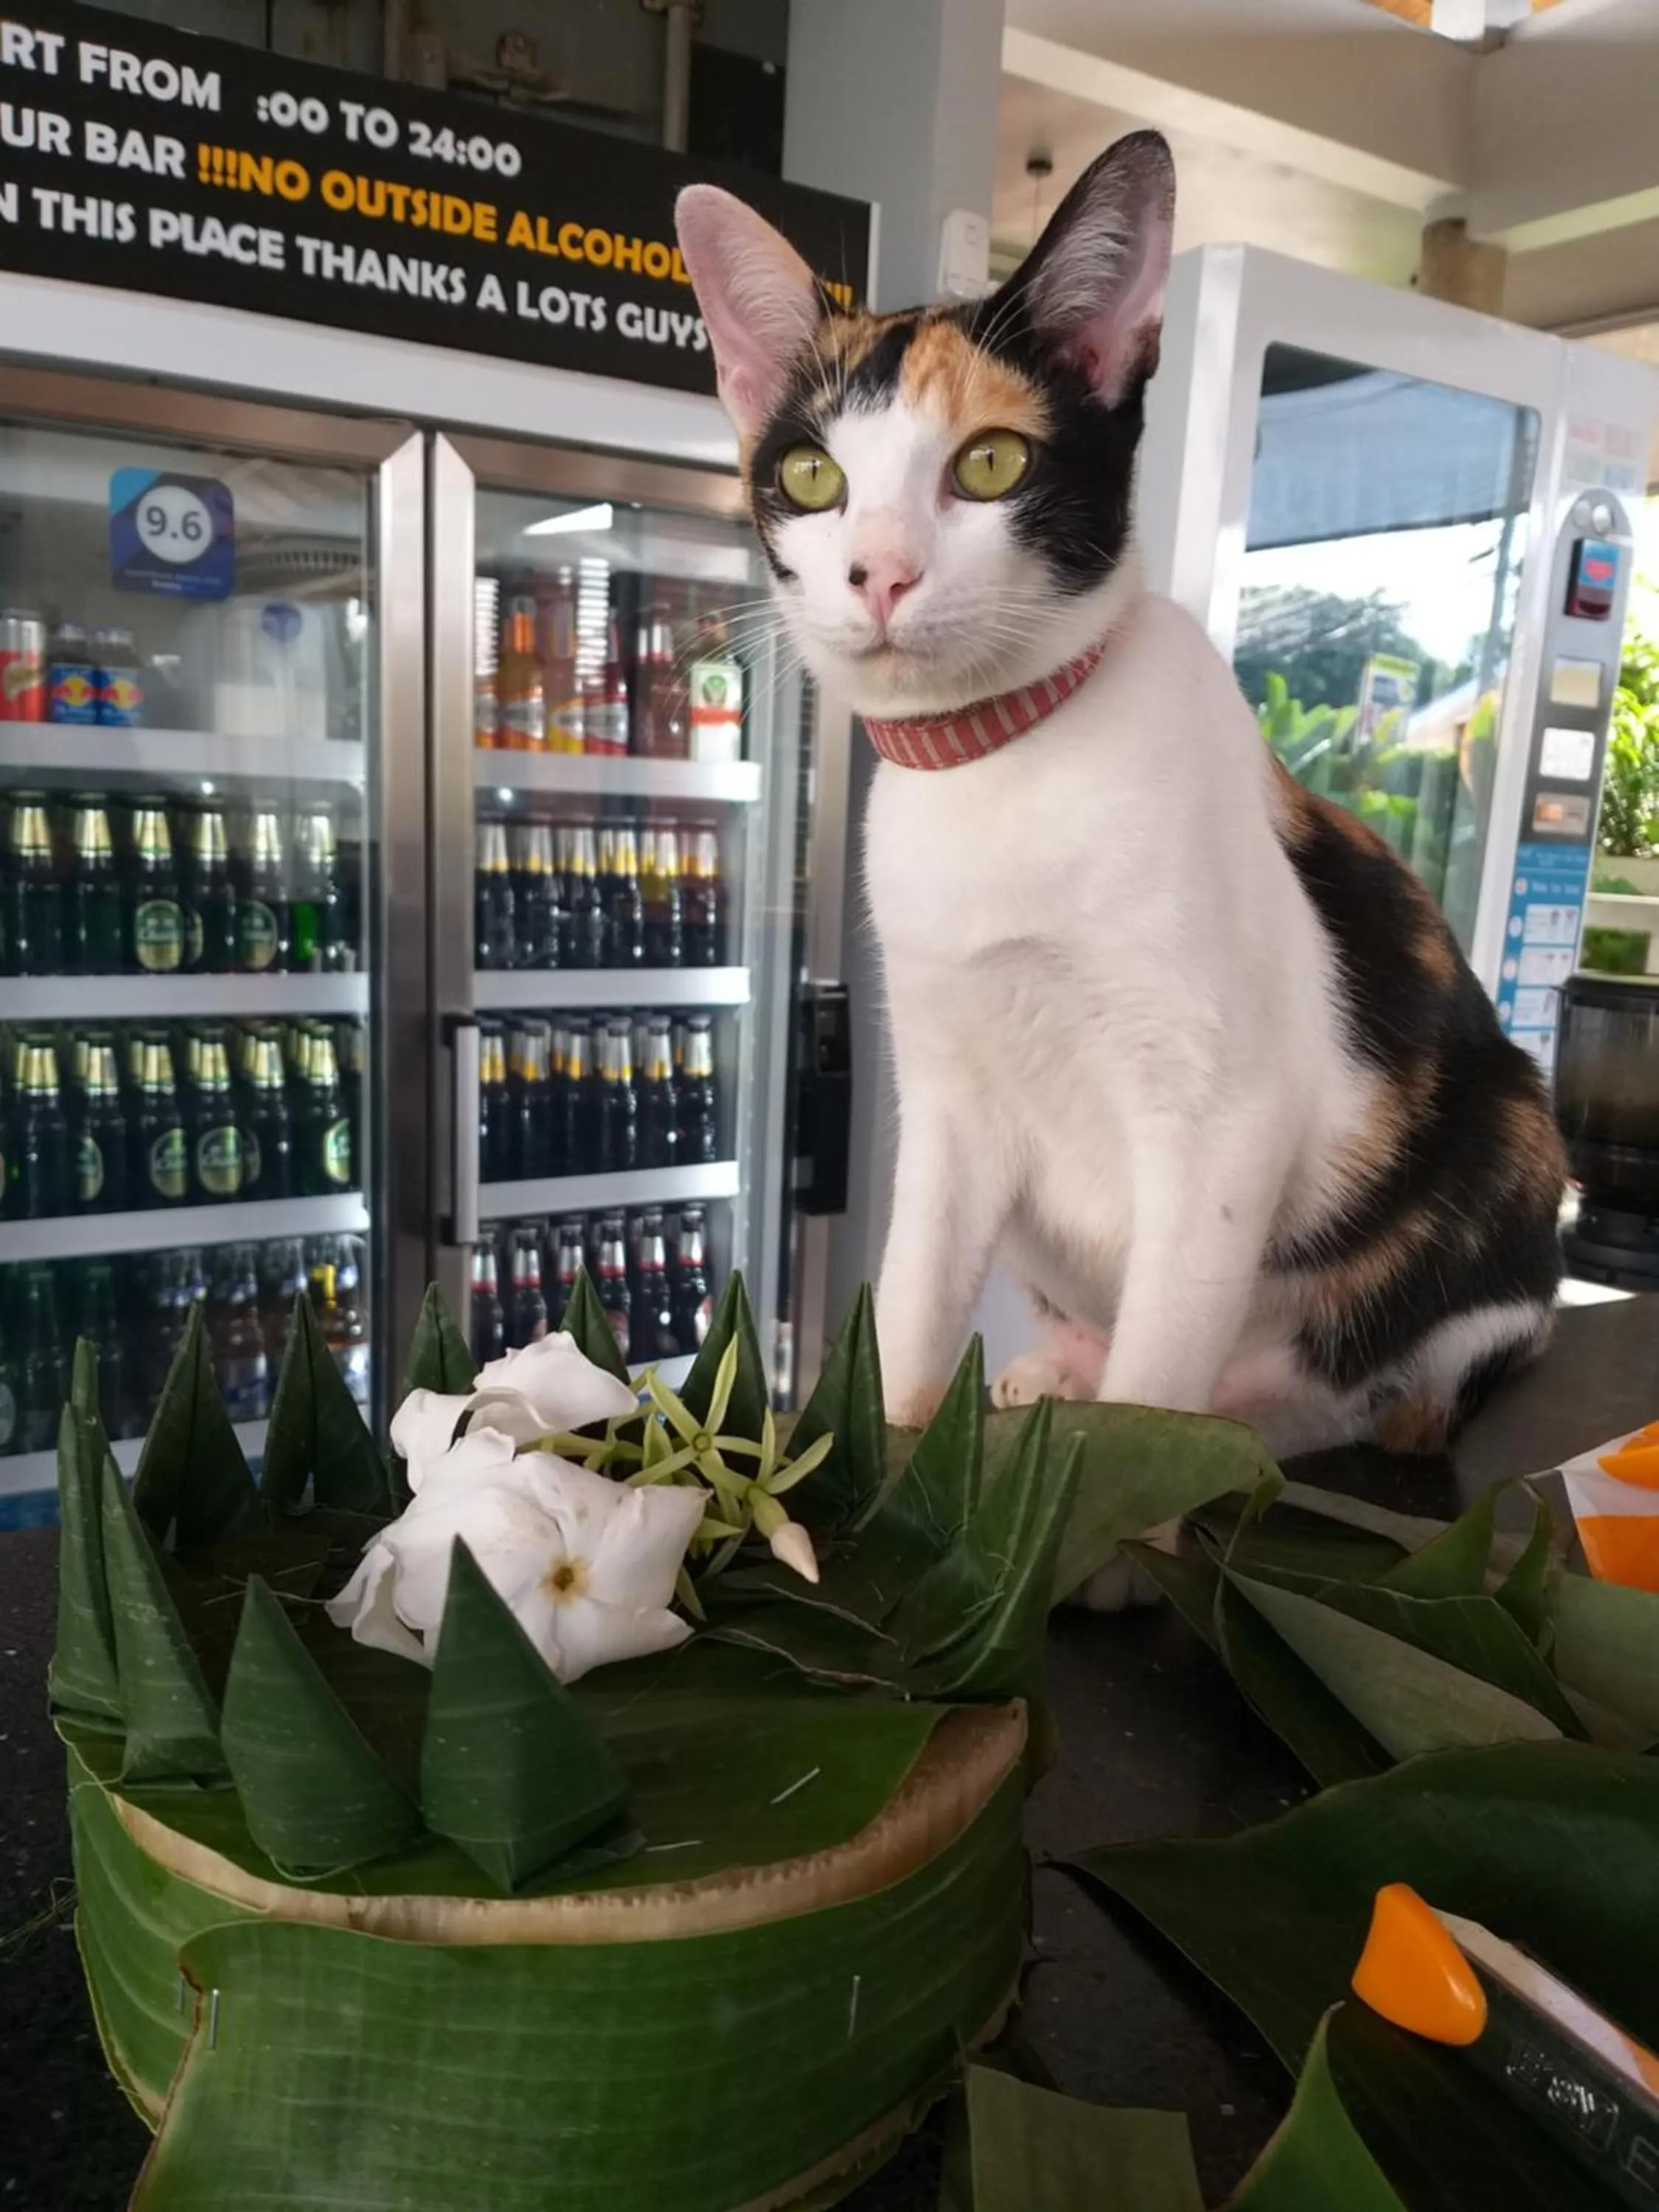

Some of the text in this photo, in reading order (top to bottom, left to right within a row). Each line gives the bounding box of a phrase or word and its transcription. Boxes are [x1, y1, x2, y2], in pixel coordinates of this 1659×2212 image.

[78, 41, 220, 111] FROM
[339, 100, 399, 148] TO
[408, 122, 521, 177] 24:00
[32, 187, 136, 243] THIS
[149, 208, 285, 270] PLACE
[295, 235, 467, 304] THANKS
[476, 274, 507, 313] A
[517, 281, 607, 332] LOTS
[616, 302, 708, 351] GUYS
[84, 121, 186, 178] BAR
[321, 170, 498, 242] OUTSIDE
[506, 211, 692, 284] ALCOHOL
[146, 505, 202, 541] 9.6
